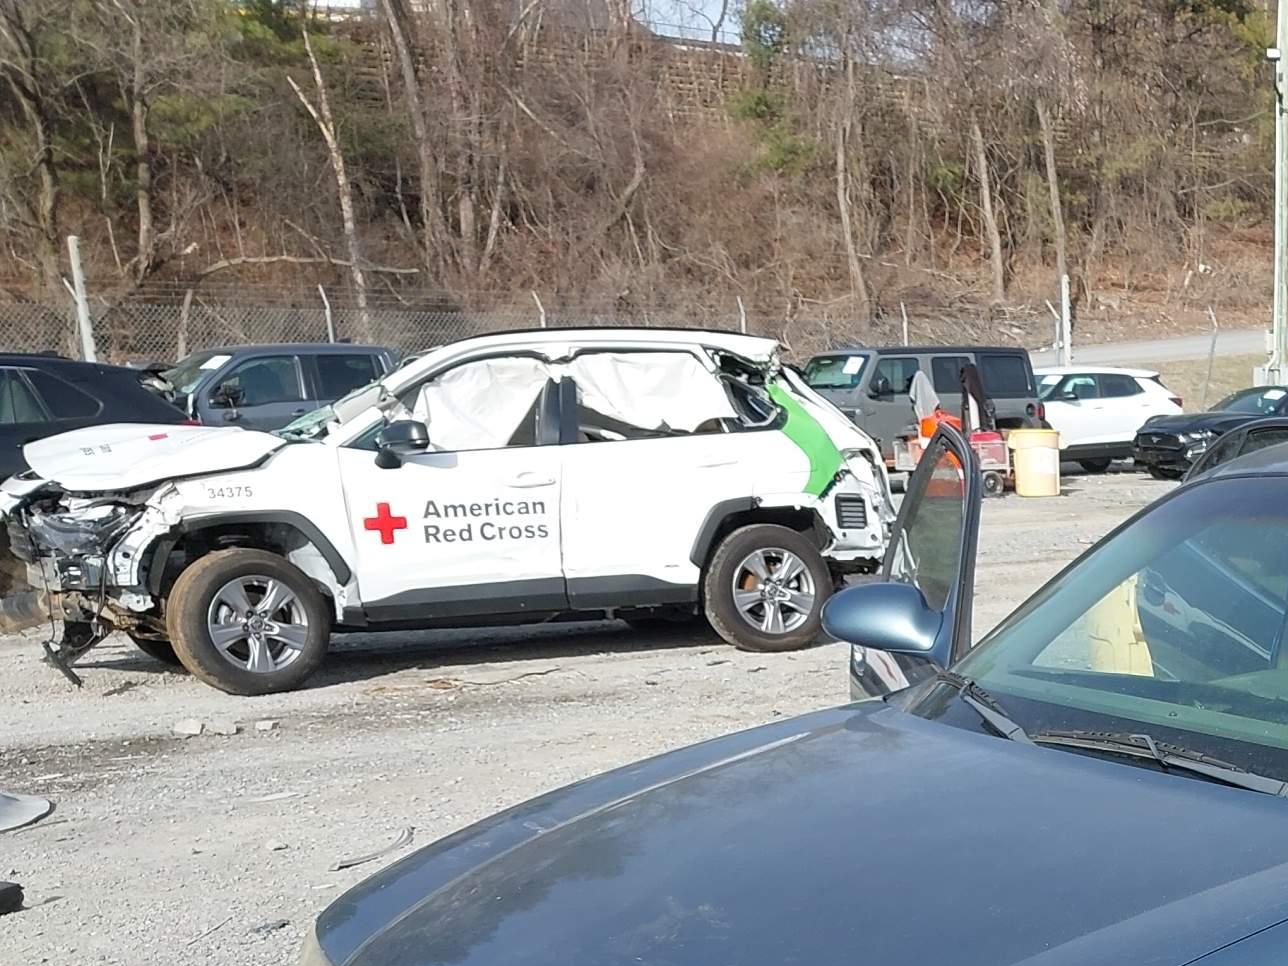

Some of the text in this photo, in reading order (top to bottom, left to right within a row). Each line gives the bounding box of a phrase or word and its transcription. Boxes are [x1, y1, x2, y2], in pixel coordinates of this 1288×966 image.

[207, 486, 253, 499] 34375
[423, 498, 546, 519] American
[423, 522, 549, 543] Red Cross
